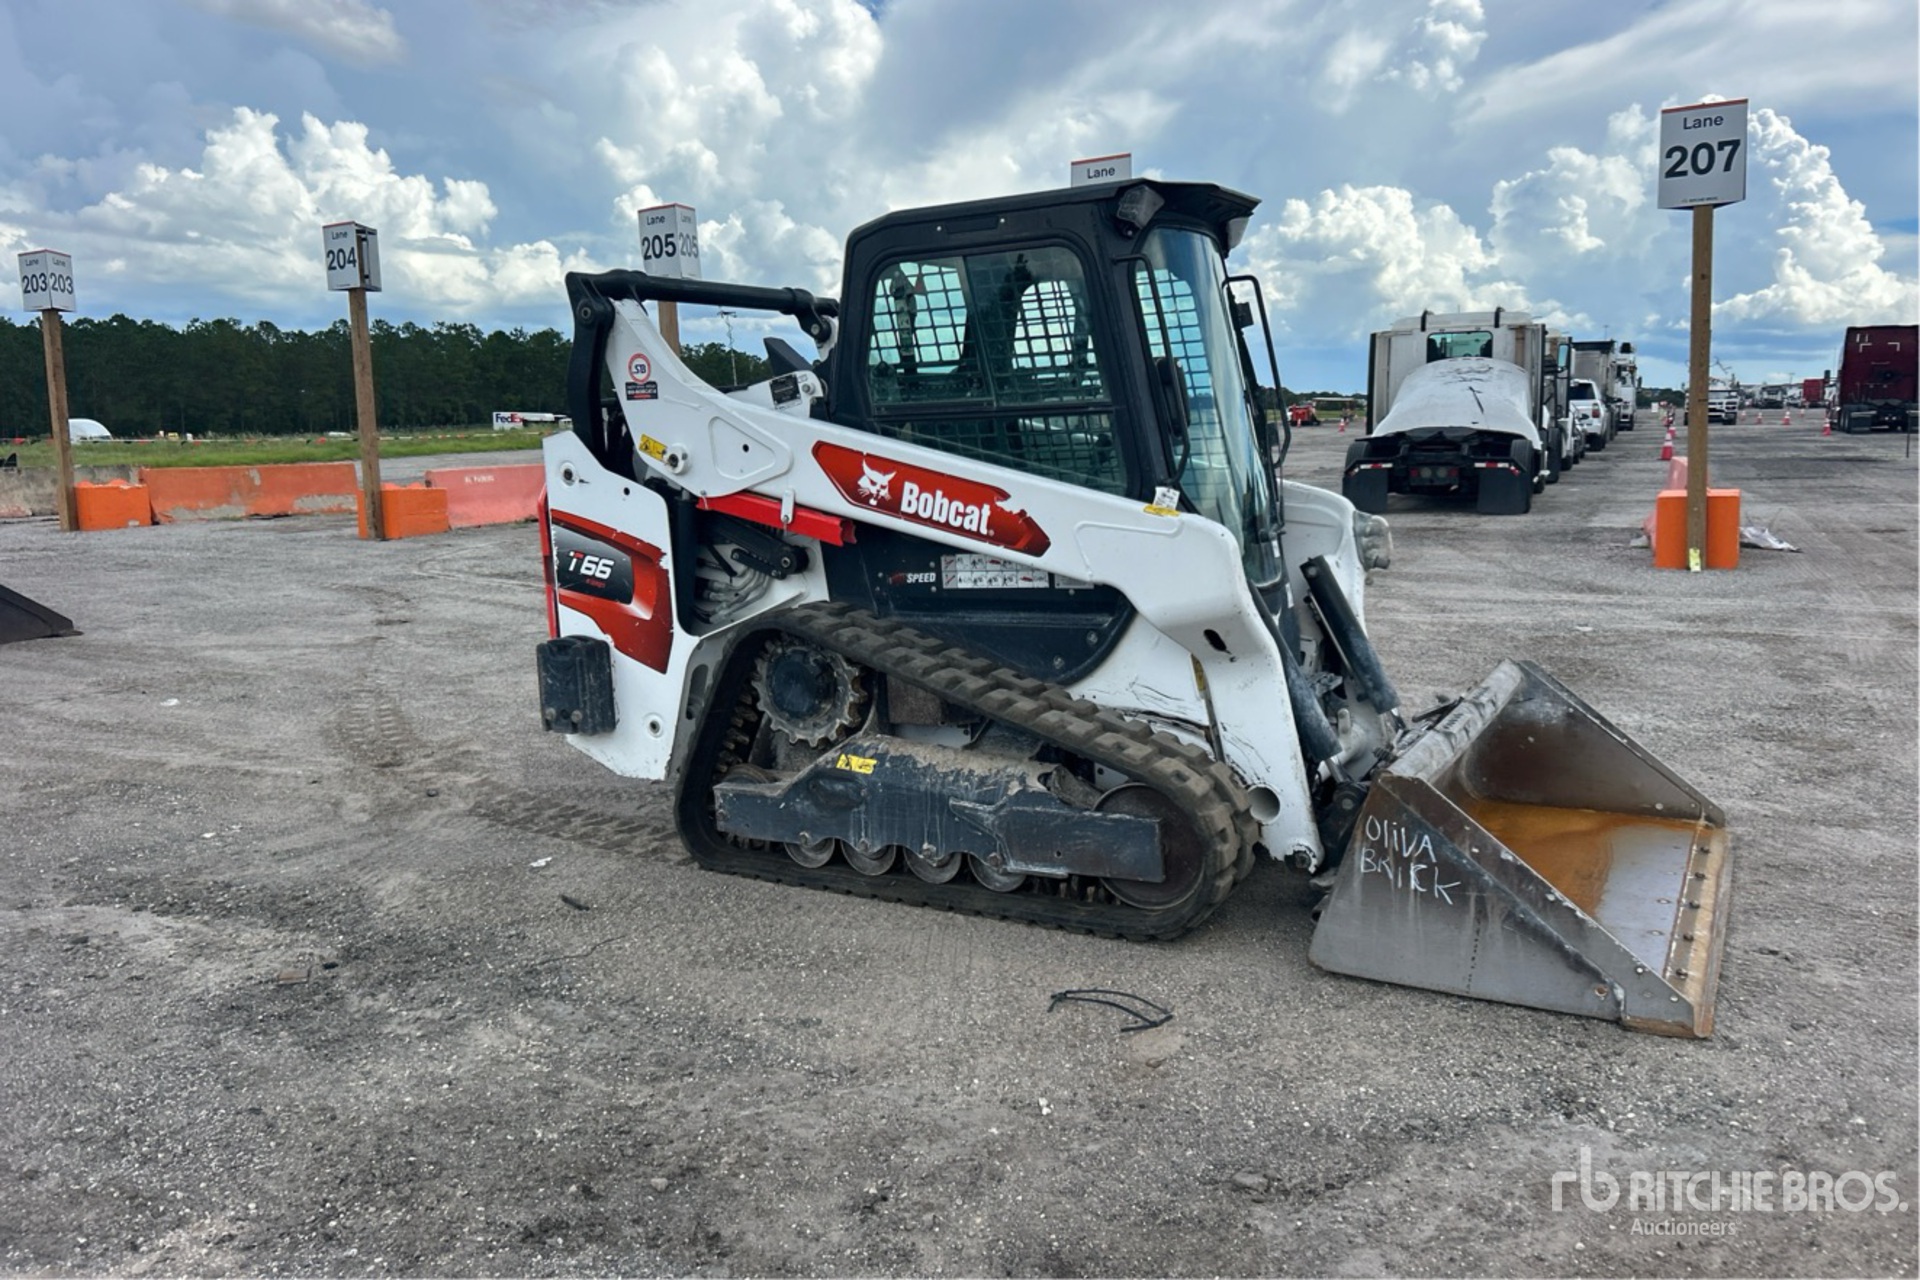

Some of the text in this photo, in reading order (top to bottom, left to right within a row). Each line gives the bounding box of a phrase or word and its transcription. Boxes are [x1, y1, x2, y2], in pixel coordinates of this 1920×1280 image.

[1683, 115, 1724, 130] Lane
[1664, 139, 1741, 179] 207
[1087, 167, 1115, 179] Lane
[647, 215, 665, 225] Lane
[332, 231, 348, 240] Lane
[642, 233, 676, 260] 205
[679, 232, 699, 258] 205
[327, 246, 357, 270] 204
[22, 272, 47, 294] 203
[50, 272, 74, 295] 203
[901, 481, 990, 535] Bobcat
[568, 551, 615, 579] T66
[906, 572, 936, 583] SPEED
